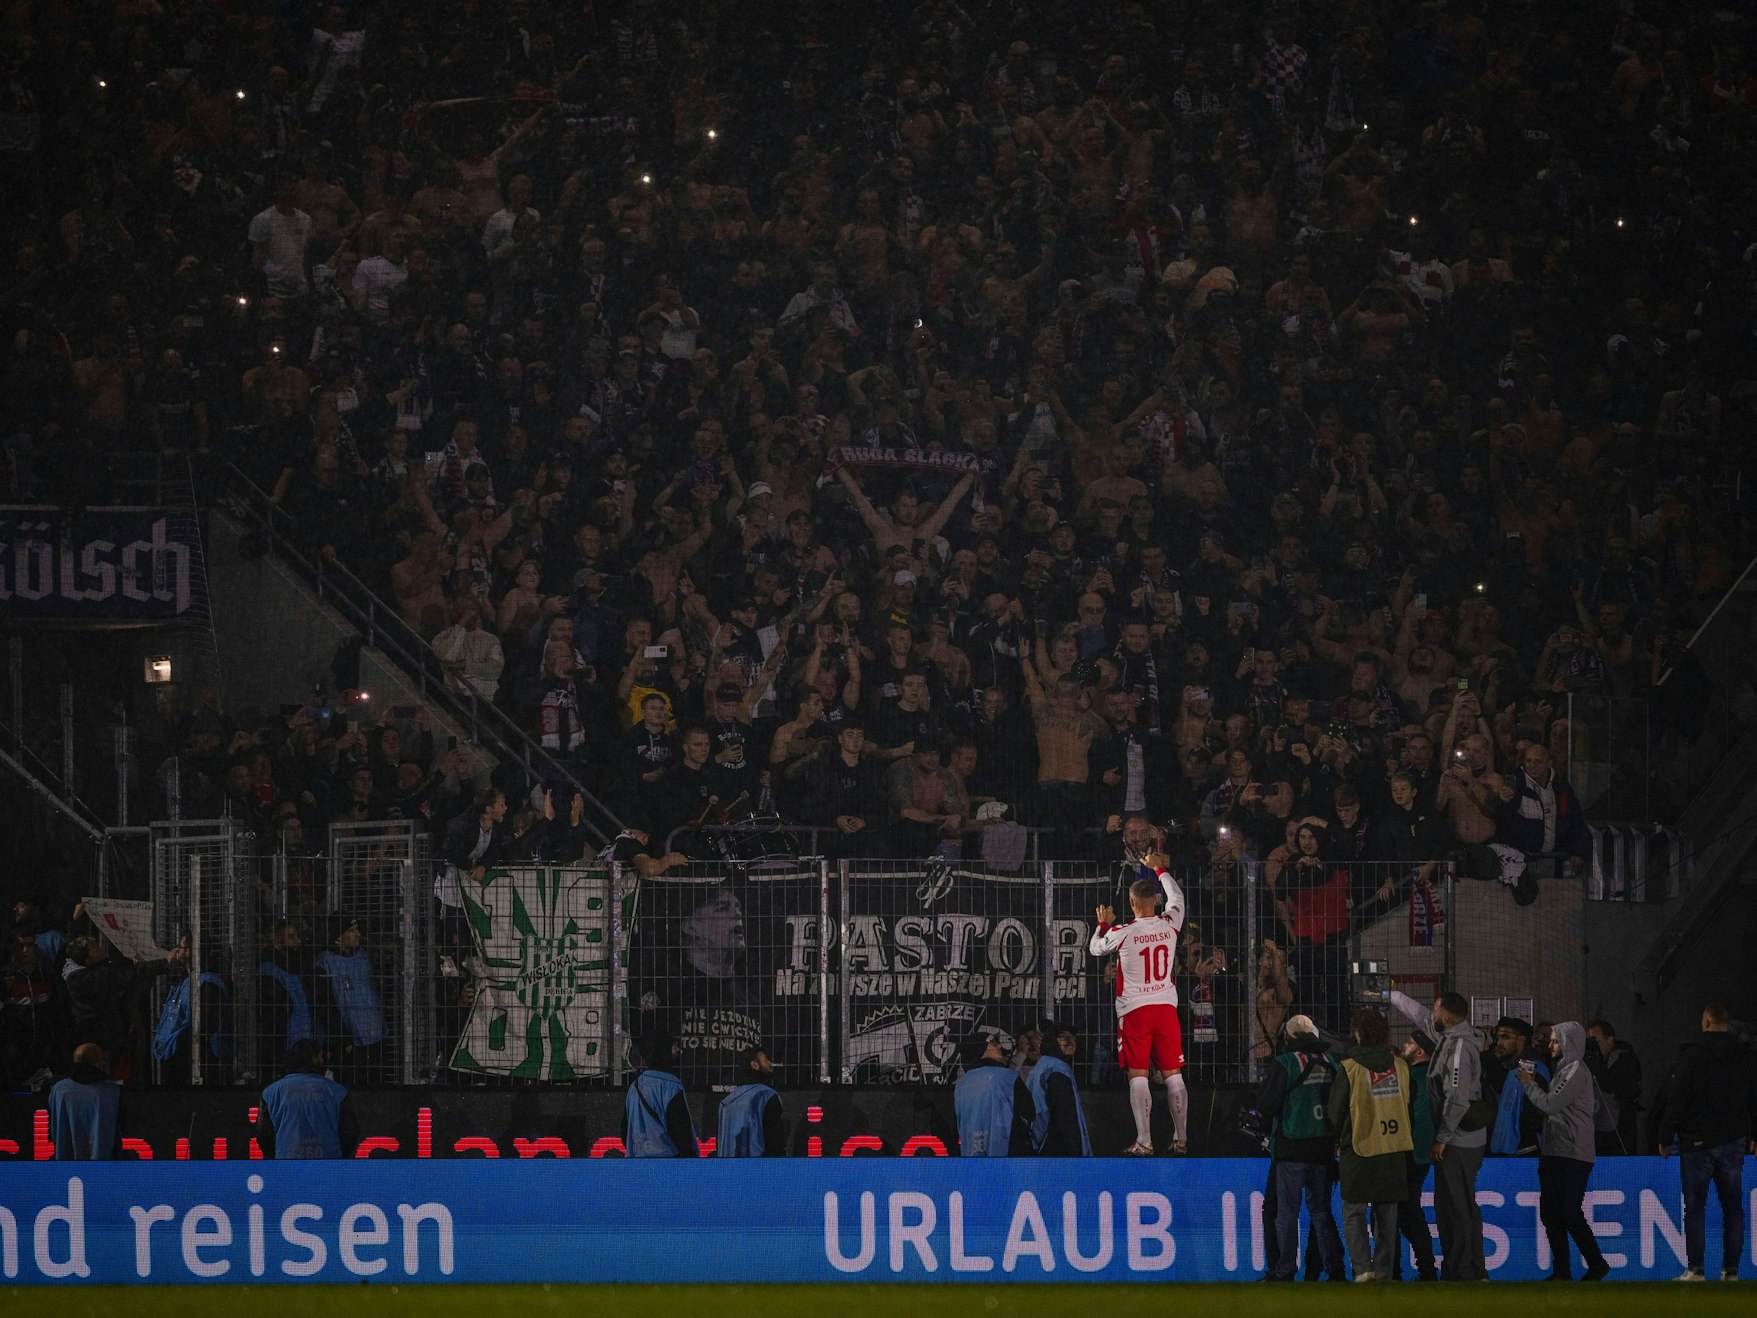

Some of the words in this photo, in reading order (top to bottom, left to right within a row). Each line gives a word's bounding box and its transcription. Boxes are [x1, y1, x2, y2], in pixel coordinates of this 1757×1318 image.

[0, 516, 191, 615] ölsch
[786, 913, 1091, 975] PASTOR
[1134, 931, 1171, 944] PODOLSKI
[776, 968, 806, 996] Na
[897, 974, 915, 996] w
[920, 968, 991, 999] Naszej
[1139, 944, 1169, 984] 10
[681, 1022, 705, 1034] NIE
[681, 1036, 700, 1049] TO
[129, 1174, 454, 1278] reisen
[824, 1190, 1176, 1273] URLAUB
